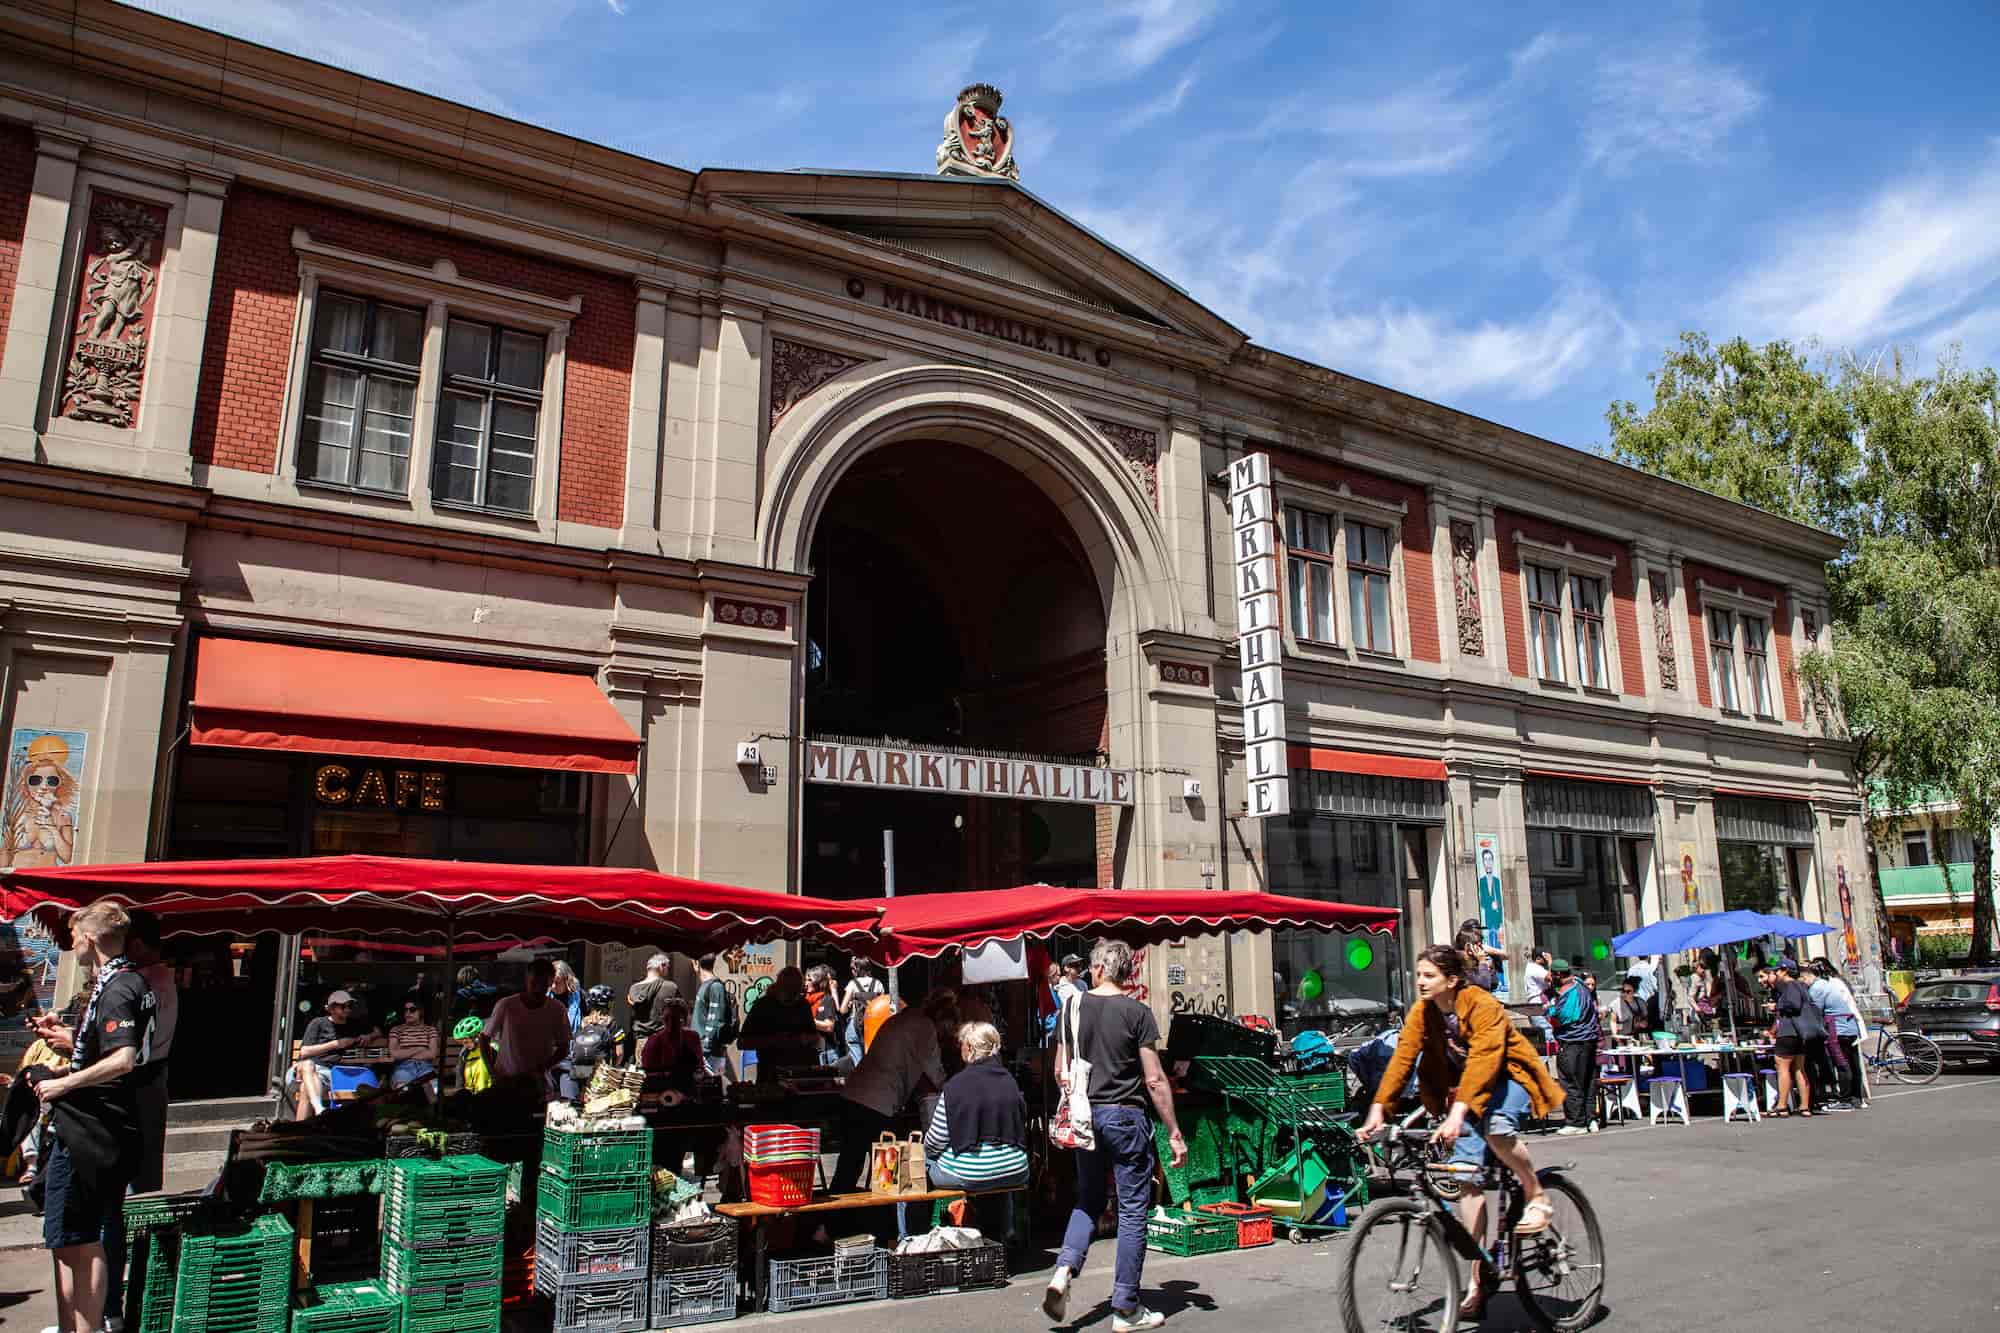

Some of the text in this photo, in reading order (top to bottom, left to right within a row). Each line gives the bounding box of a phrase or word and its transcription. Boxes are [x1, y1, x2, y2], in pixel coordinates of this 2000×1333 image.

[1234, 459, 1272, 814] MARKTHALLE
[744, 747, 756, 759] 43
[807, 746, 1129, 801] MARKTHALLE
[316, 765, 444, 810] CAFE
